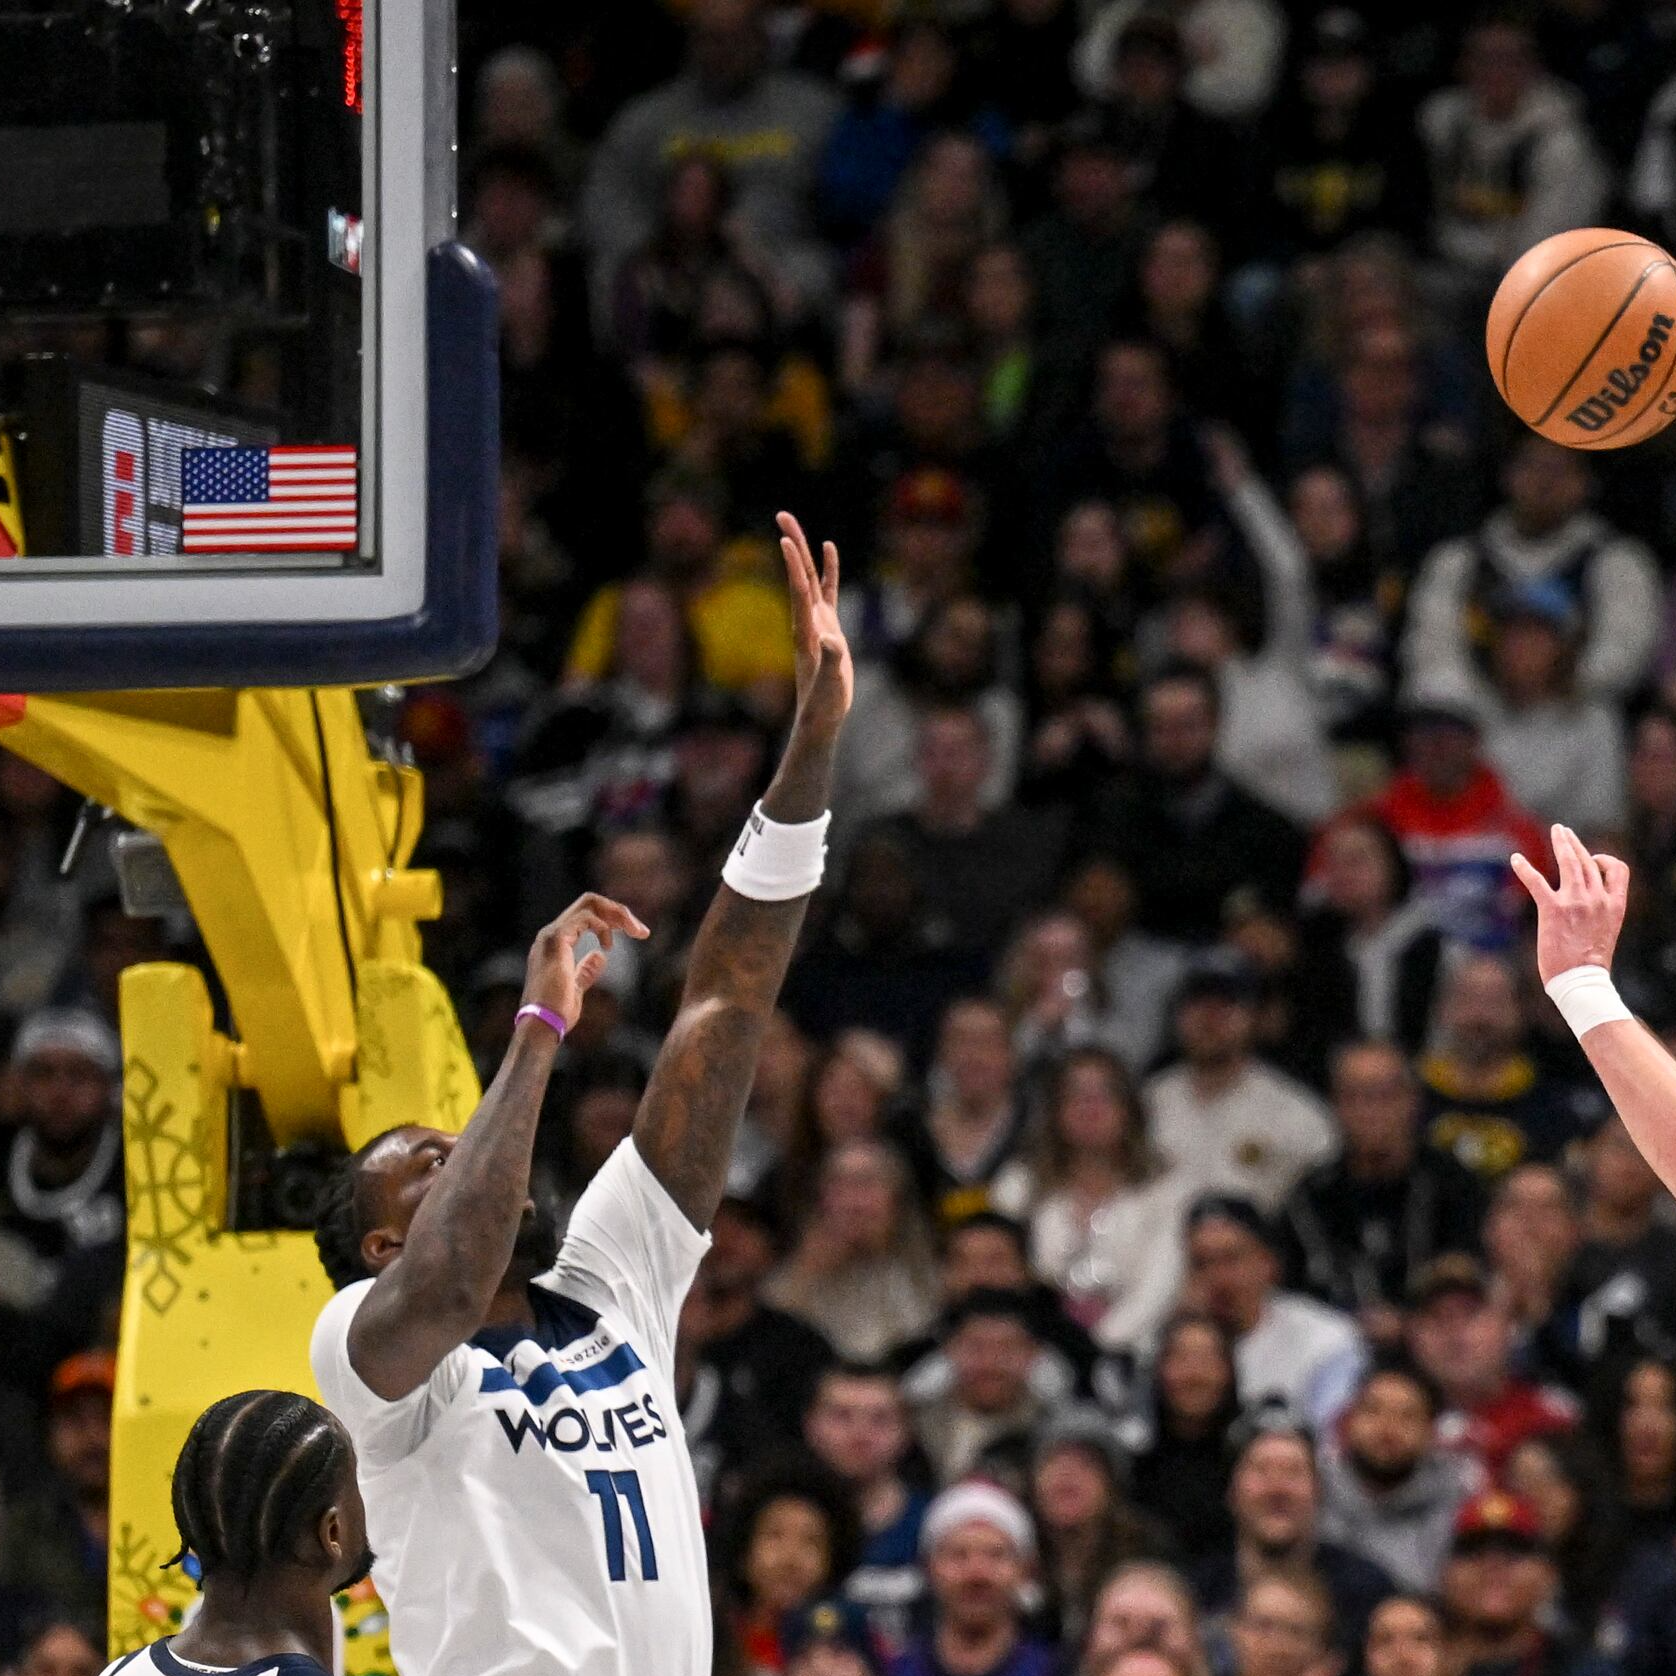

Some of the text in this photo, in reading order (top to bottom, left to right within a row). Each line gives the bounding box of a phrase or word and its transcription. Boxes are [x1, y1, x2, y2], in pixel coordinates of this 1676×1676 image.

[1566, 313, 1675, 431] Wilson
[494, 1393, 667, 1455] WOLVES
[584, 1469, 659, 1582] 11
